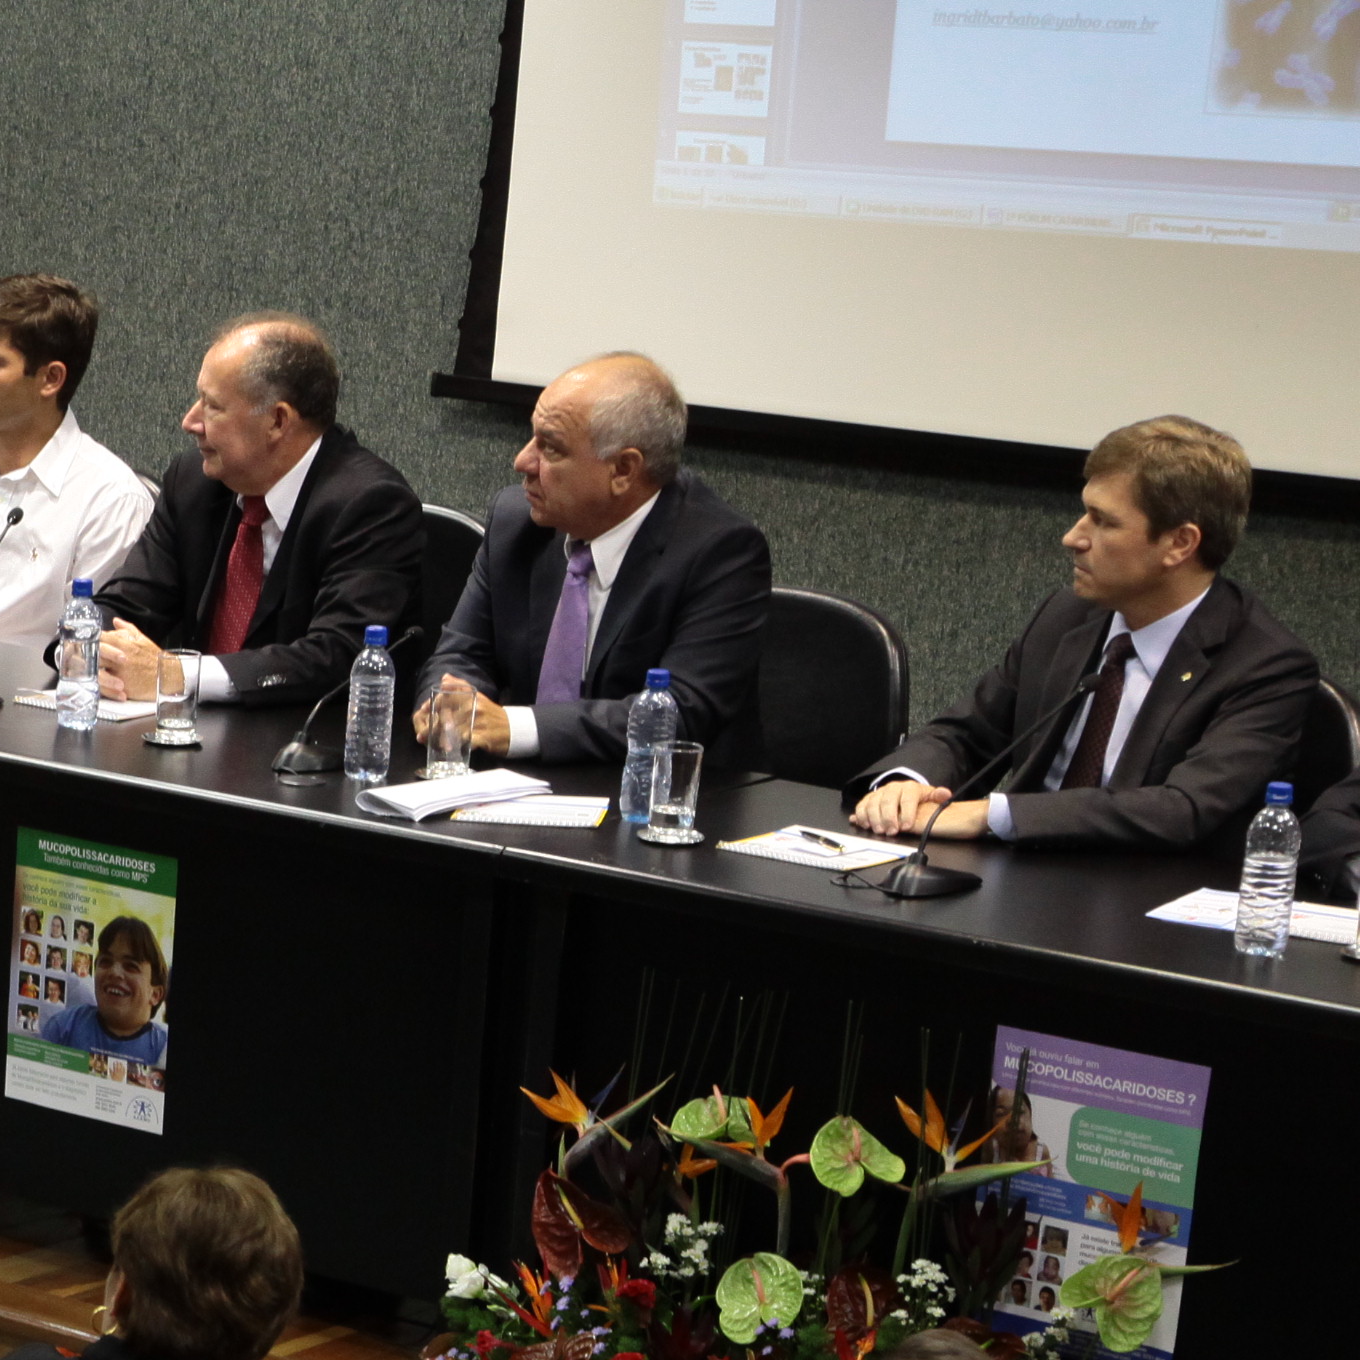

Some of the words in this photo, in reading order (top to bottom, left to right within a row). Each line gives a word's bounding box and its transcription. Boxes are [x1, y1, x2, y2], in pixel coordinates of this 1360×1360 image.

[38, 839, 155, 873] MUCOPOLISSACARIDOSES
[43, 852, 70, 866] Também
[72, 858, 109, 875] conhecidas
[110, 868, 130, 880] como
[1063, 1053, 1082, 1065] falar
[1085, 1059, 1100, 1069] em
[1186, 1093, 1196, 1106] ?
[1075, 1152, 1098, 1165] uma
[1099, 1156, 1140, 1173] história
[1142, 1165, 1156, 1177] de
[1157, 1169, 1181, 1183] vida
[1076, 1139, 1102, 1154] você
[1103, 1145, 1131, 1161] pode
[1132, 1151, 1184, 1171] modificar
